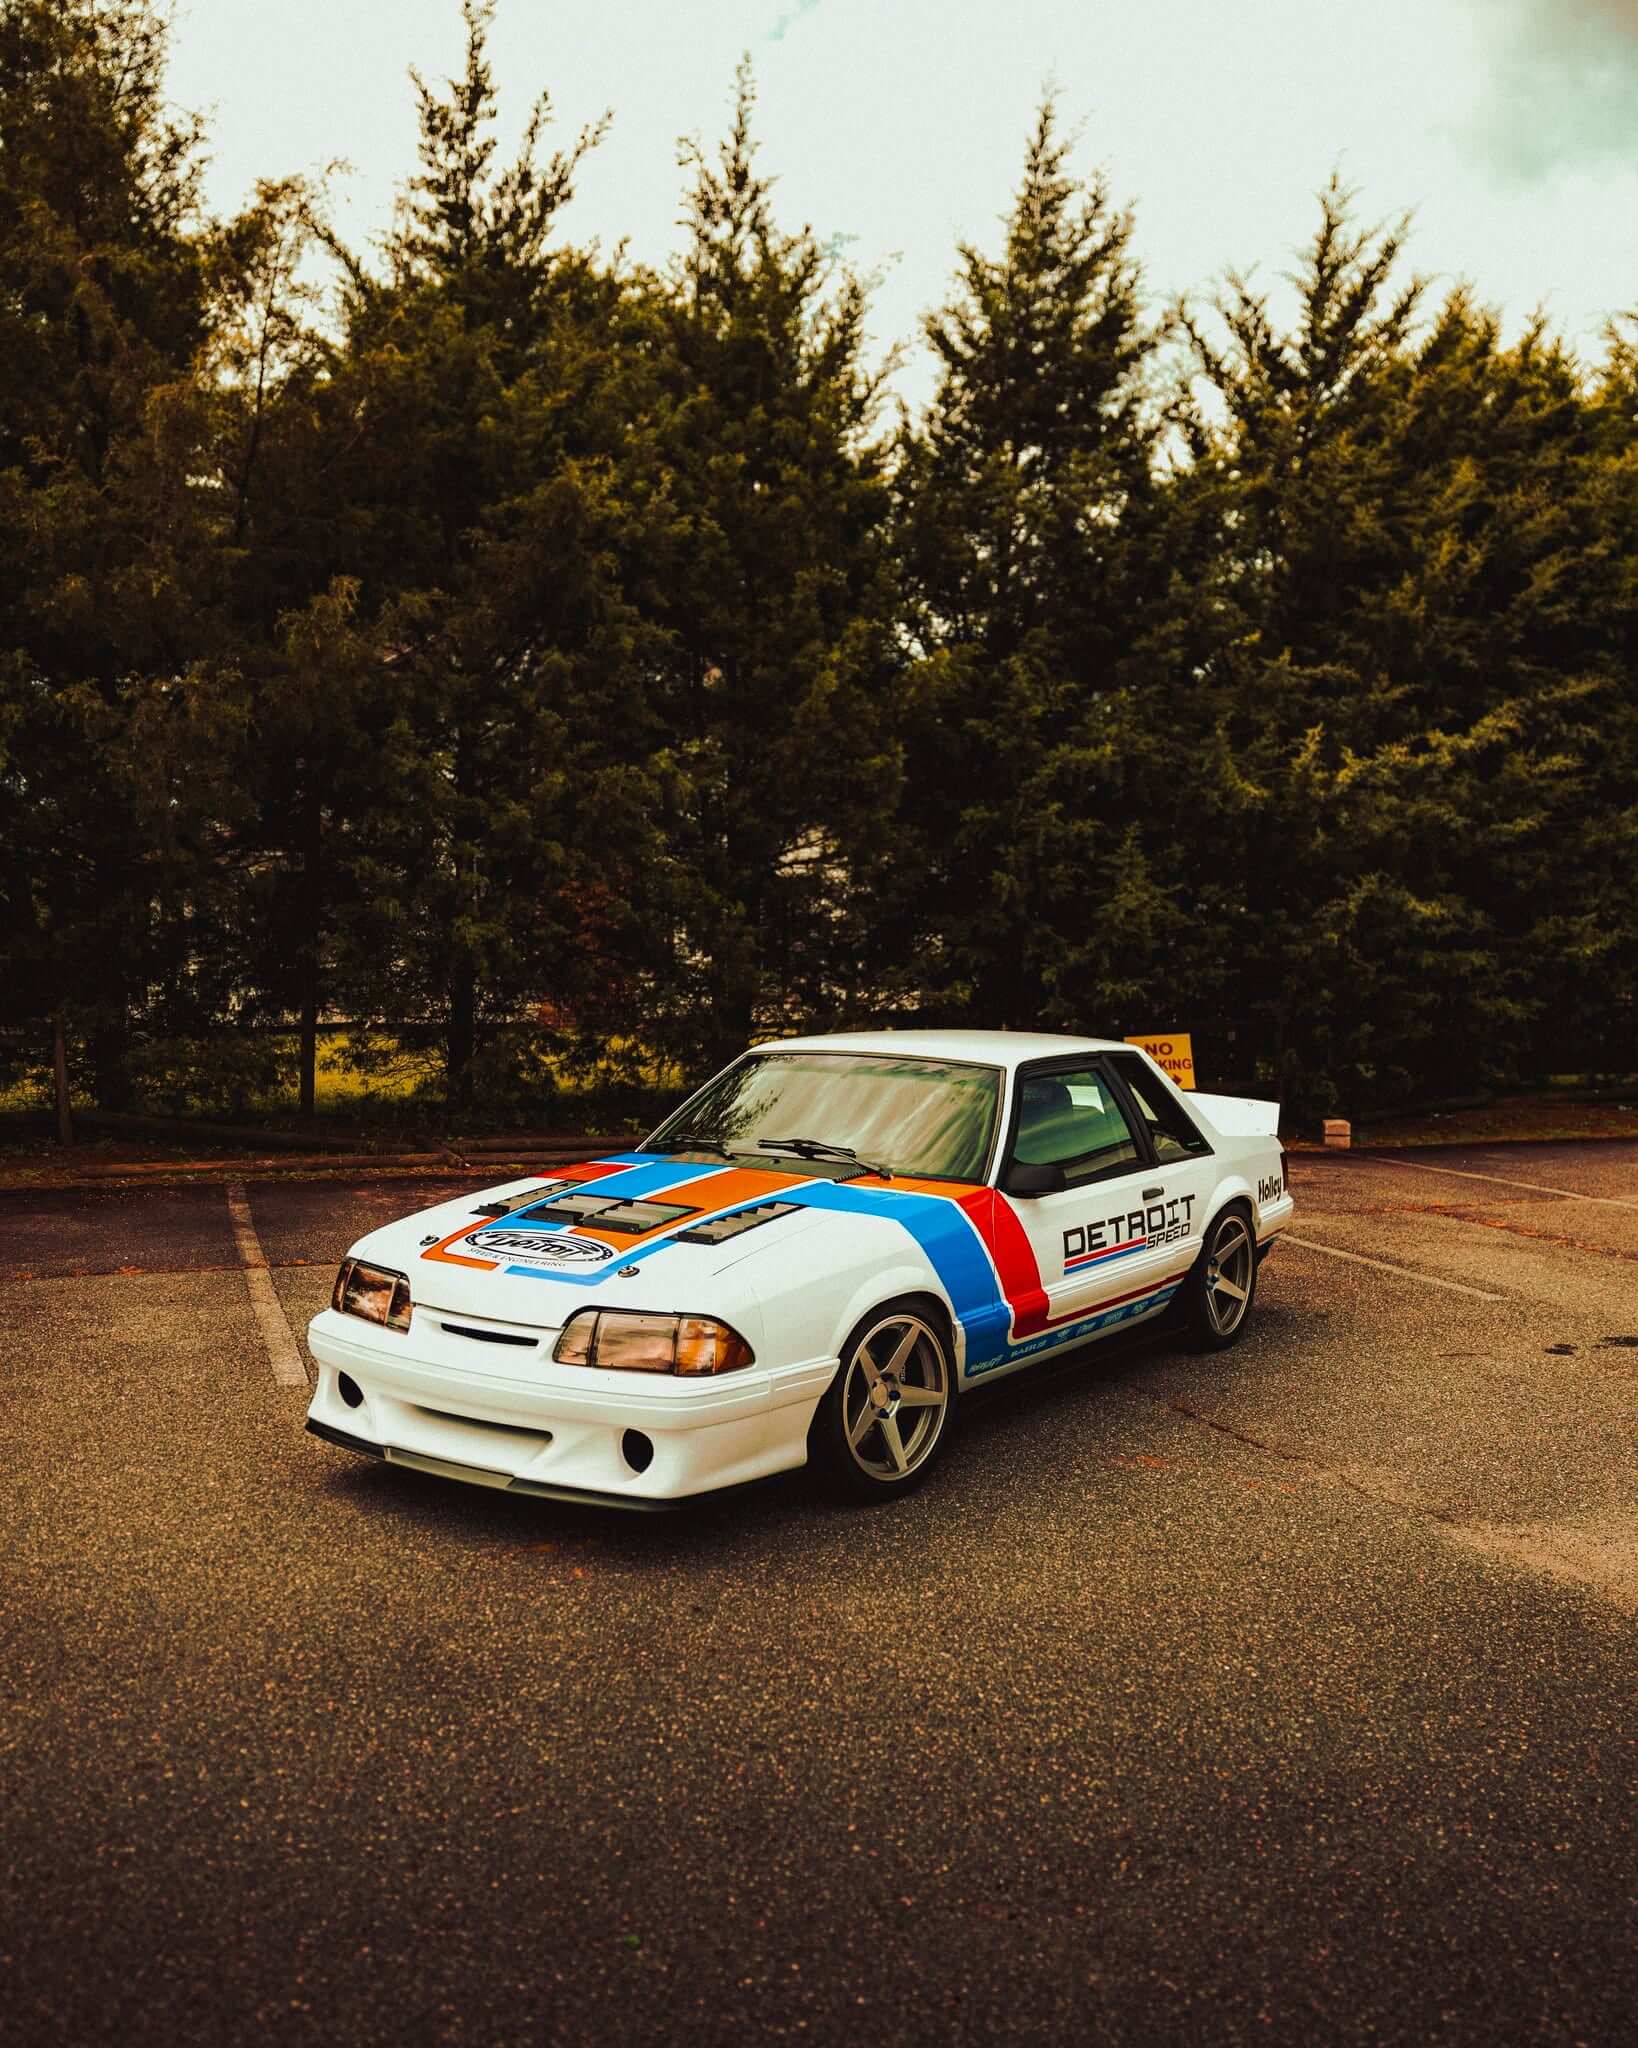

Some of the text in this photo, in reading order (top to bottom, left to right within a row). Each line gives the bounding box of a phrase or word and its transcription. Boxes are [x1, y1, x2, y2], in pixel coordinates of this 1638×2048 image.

[1144, 1042, 1173, 1056] NO
[1158, 1058, 1192, 1071] KING
[1258, 1176, 1282, 1204] Holley
[1063, 1194, 1195, 1259] DETROIT
[1146, 1222, 1191, 1250] SPEED
